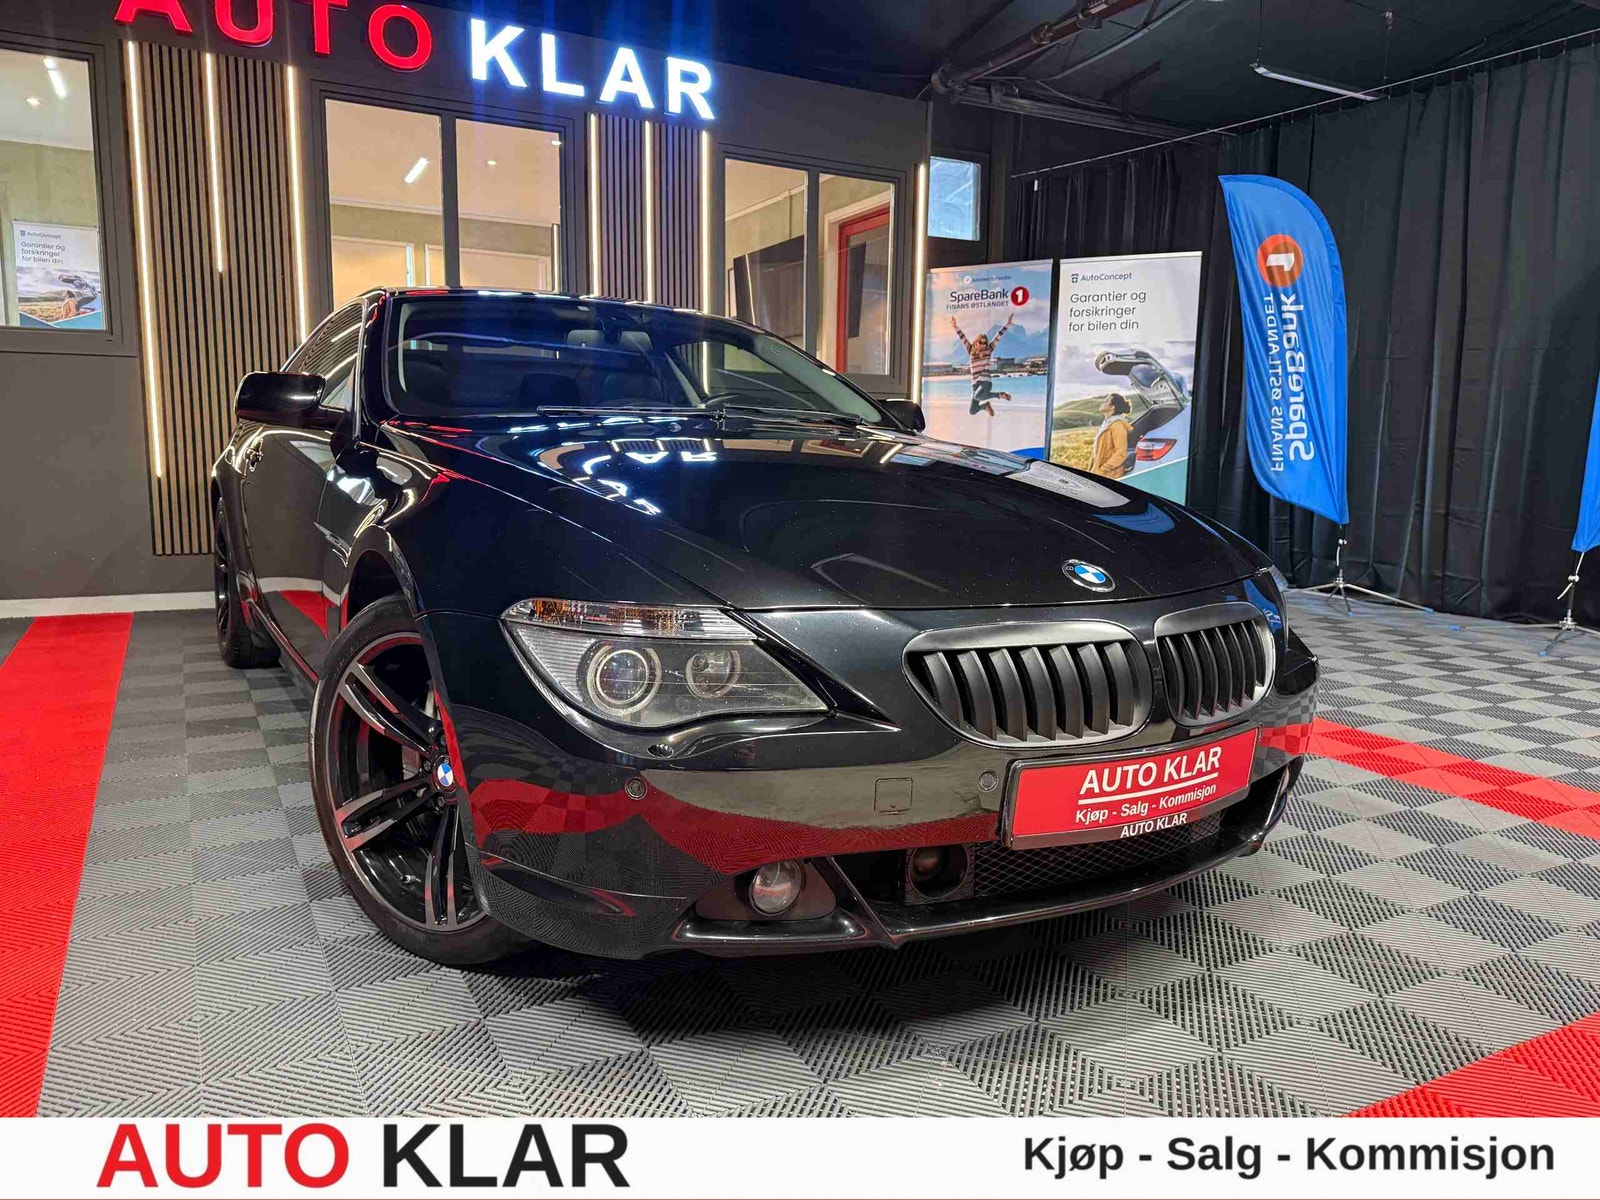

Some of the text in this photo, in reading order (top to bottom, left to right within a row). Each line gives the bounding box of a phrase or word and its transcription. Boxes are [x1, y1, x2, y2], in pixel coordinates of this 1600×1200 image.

[470, 18, 715, 119] KLAR
[21, 241, 54, 250] Garantier
[21, 248, 60, 258] forsikringer
[1081, 272, 1132, 282] AutoConcept
[950, 288, 1009, 303] SpareBank
[1070, 291, 1147, 304] Garantier og
[971, 300, 1009, 309] ØSTLANDET
[1069, 306, 1136, 318] forsikringer
[1069, 319, 1139, 332] for bilen din
[1079, 746, 1222, 795] AUTO KLAR
[1075, 809, 1109, 825] Kjøp
[1120, 800, 1149, 817] Salg
[1159, 784, 1217, 809] Kommisjon
[1120, 813, 1188, 839] AUTO KLAR
